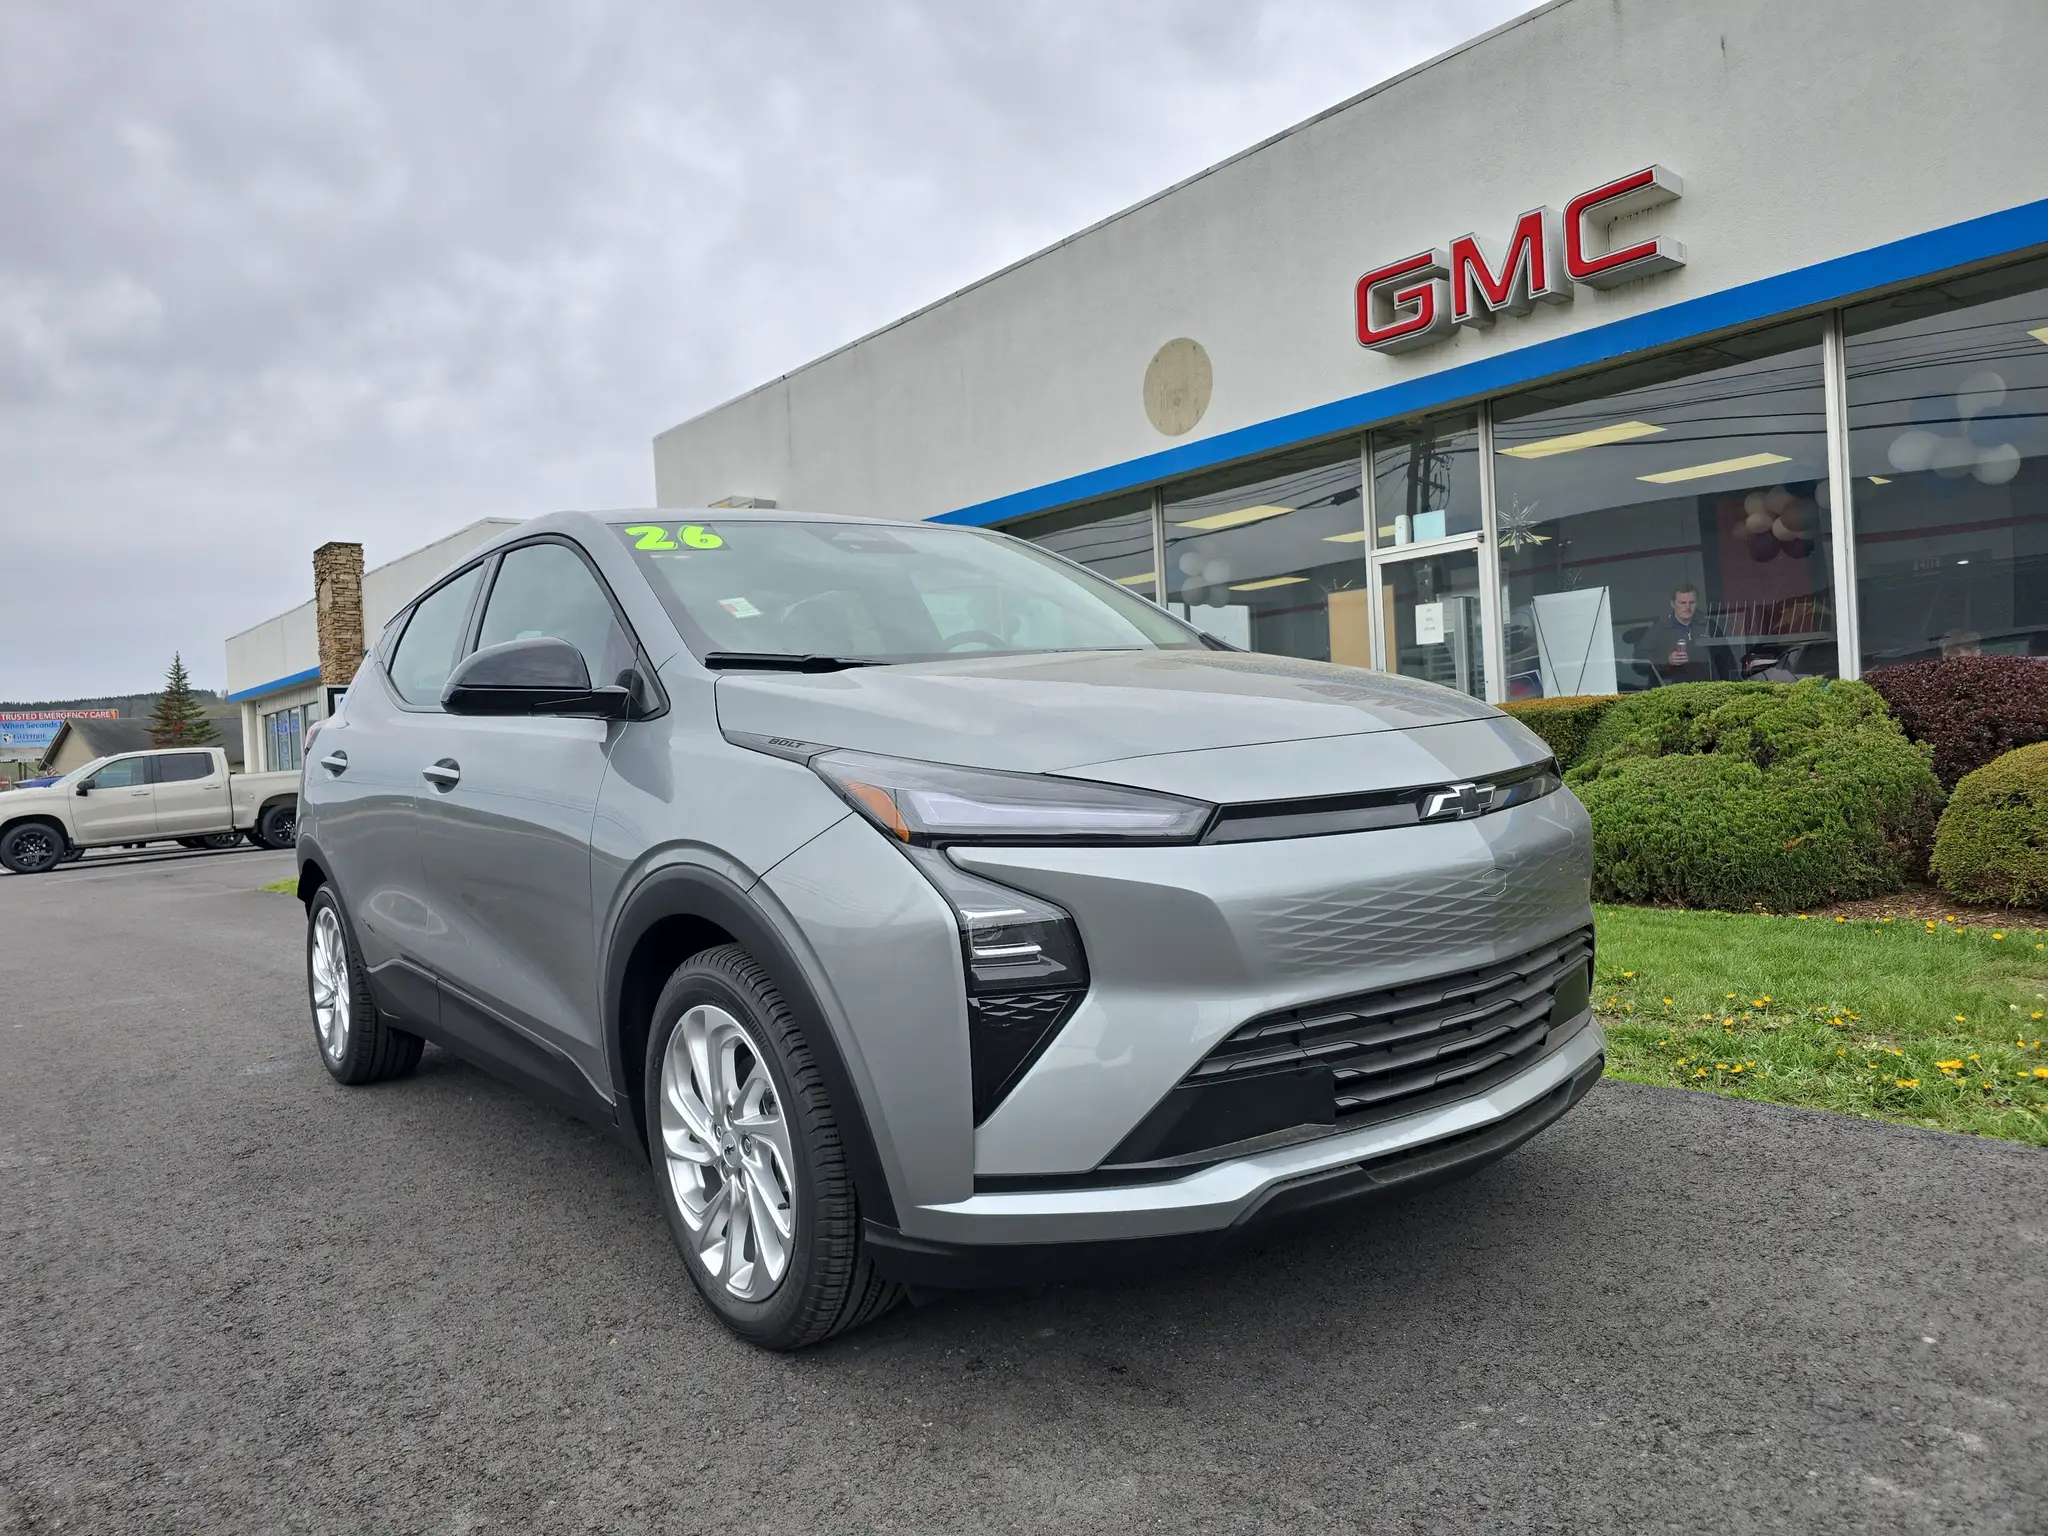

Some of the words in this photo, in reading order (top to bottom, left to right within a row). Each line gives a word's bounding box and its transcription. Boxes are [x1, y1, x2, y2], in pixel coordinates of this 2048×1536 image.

[1355, 164, 1686, 354] GMC
[625, 525, 723, 550] 26
[1, 713, 37, 721] TRUSTED
[39, 711, 89, 720] EMERGENCY
[768, 738, 806, 748] BOLT
